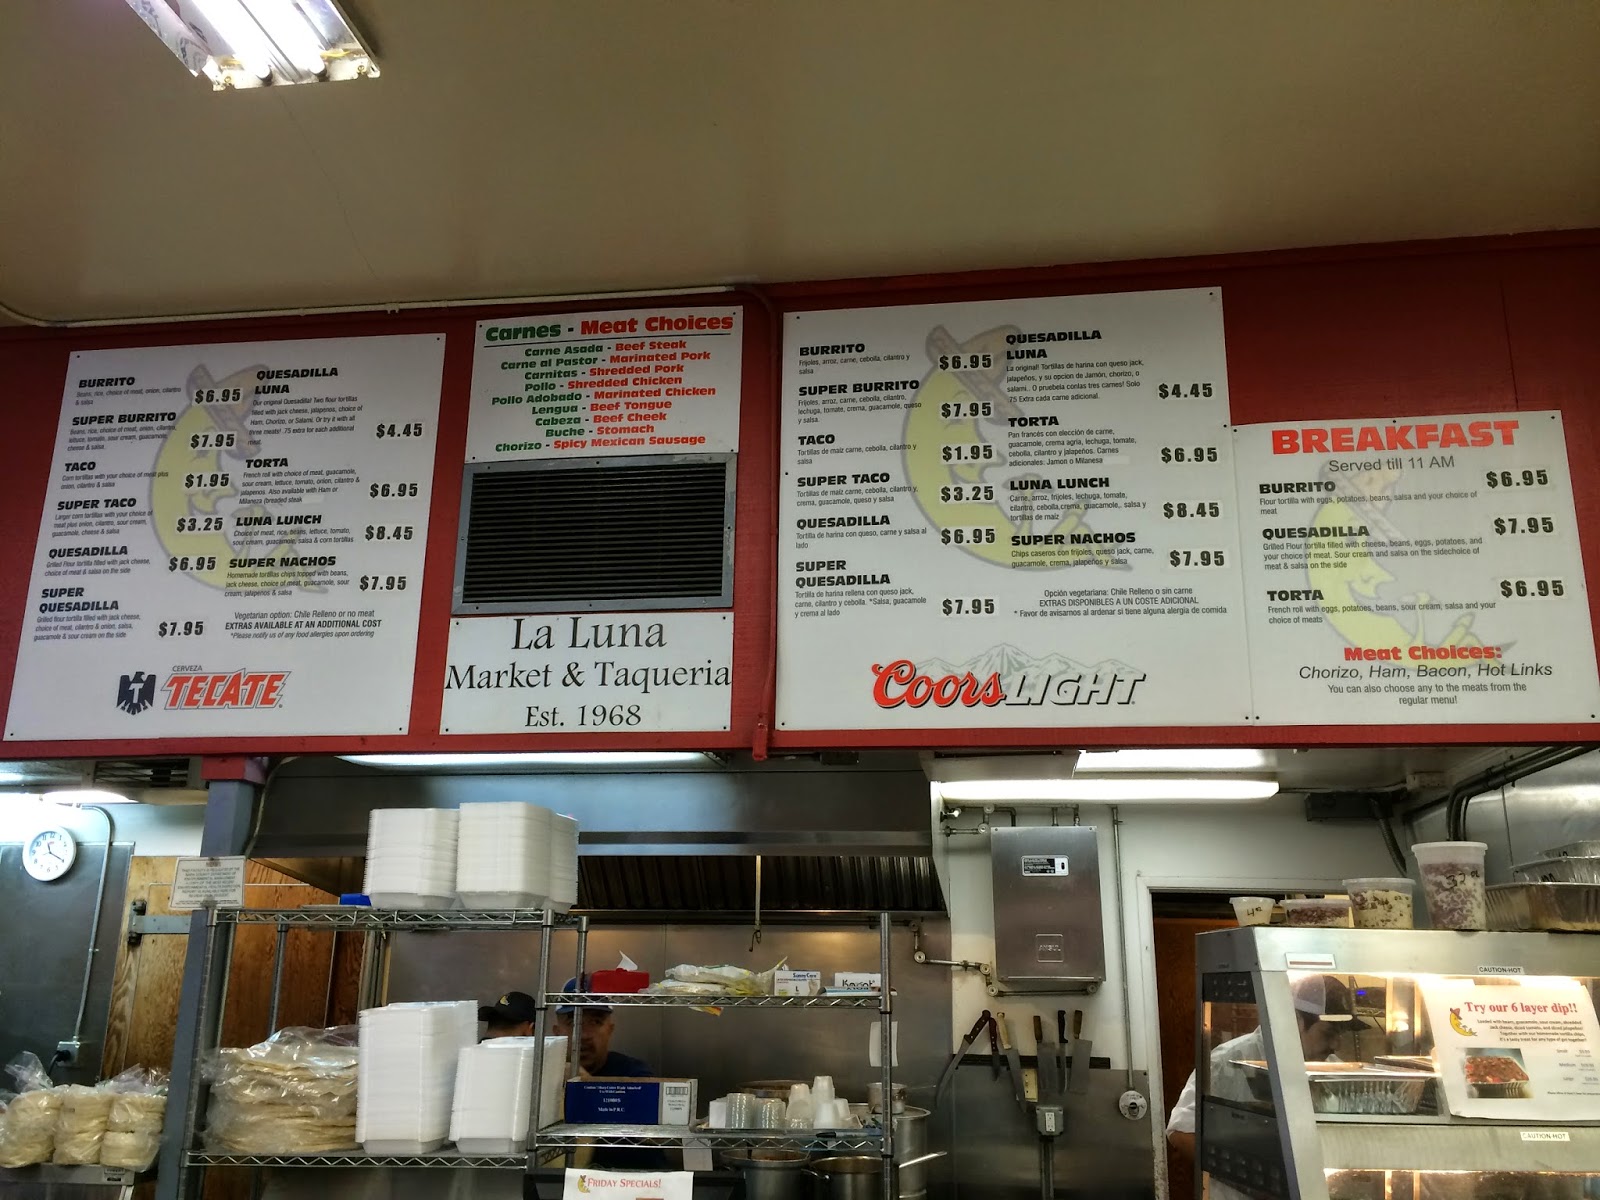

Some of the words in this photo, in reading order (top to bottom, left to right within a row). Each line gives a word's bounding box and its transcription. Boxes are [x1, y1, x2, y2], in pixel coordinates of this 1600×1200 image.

[486, 323, 561, 341] Carnes
[581, 319, 638, 334] Meat
[645, 315, 733, 332] Choices
[1006, 329, 1101, 345] QUESADILLA
[525, 346, 560, 356] Carne
[564, 344, 603, 354] Asada
[616, 341, 645, 351] Beef
[650, 340, 687, 350] Steak
[799, 343, 865, 356] BURRITO
[1006, 348, 1047, 360] LUNA
[501, 360, 536, 370] Carne
[540, 358, 551, 368] al
[556, 356, 598, 366] Pastor
[610, 353, 676, 363] Marinated
[680, 351, 710, 360] Pork
[939, 354, 992, 370] $6.95
[256, 367, 339, 380] QUESADILLA
[524, 369, 578, 380] Carnitas
[590, 366, 650, 376] Shredded
[655, 364, 684, 373] Pork
[79, 377, 135, 388] BURRITO
[254, 384, 290, 395] LUNA
[525, 382, 556, 391] Pollo
[568, 378, 628, 389] Shredded
[632, 376, 682, 386] Chicken
[799, 383, 848, 396] SUPER
[853, 379, 919, 392] BURRITO
[194, 388, 241, 404] $6.95
[492, 395, 522, 405] Pollo
[526, 392, 582, 403] Adobado
[594, 389, 662, 399] Marinated
[666, 386, 716, 397] Chicken
[1158, 383, 1213, 399] $4.45
[532, 404, 578, 415] Lengua
[590, 402, 620, 412] Beef
[624, 400, 672, 410] Tongue
[941, 403, 992, 419] $7.95
[72, 415, 114, 426] SUPER
[119, 412, 176, 423] BURRITO
[536, 416, 581, 426] Cabeza
[594, 414, 623, 423] Beef
[627, 412, 666, 422] Cheek
[1008, 416, 1059, 427] TORTA
[376, 423, 422, 439] $4.45
[546, 427, 585, 437] Buche
[597, 424, 654, 434] Stomach
[1272, 420, 1519, 454] BREAKFAST
[190, 434, 235, 449] $7.95
[496, 442, 542, 452] Chorizo
[554, 439, 587, 449] Spicy
[591, 436, 645, 446] Mexican
[649, 435, 705, 446] Sausage
[798, 434, 835, 445] TACO
[942, 445, 993, 461] $1.95
[1161, 448, 1218, 463] $6.95
[65, 462, 96, 471] TACO
[245, 458, 288, 468] TORTA
[1329, 459, 1382, 472] Served
[1386, 458, 1403, 471] till
[1409, 458, 1423, 469] 11
[1430, 456, 1455, 468] AM
[185, 473, 229, 489] $1.95
[797, 475, 847, 487] SUPER
[852, 472, 890, 484] TACO
[1010, 479, 1052, 490] LUNA
[1057, 477, 1110, 488] LUNCH
[1486, 470, 1548, 488] $6.95
[370, 483, 418, 499] $6.95
[941, 486, 994, 502] $3.25
[1259, 481, 1335, 494] BURRITO
[58, 500, 100, 510] SUPER
[104, 498, 136, 508] TACO
[1337, 495, 1366, 503] potatoes,
[1370, 494, 1391, 502] beans,
[1163, 503, 1220, 518] $8.45
[176, 517, 224, 533] $3.25
[236, 516, 272, 527] LUNA
[276, 514, 322, 525] LUNCH
[797, 514, 890, 530] QUESADILLA
[1494, 517, 1554, 536] $7.95
[365, 526, 413, 542] $8.45
[941, 529, 996, 545] $6.95
[1011, 533, 1066, 546] SUPER
[1070, 532, 1136, 544] NACHOS
[1262, 526, 1369, 540] QUESADILLA
[49, 545, 128, 558] QUESADILLA
[1170, 551, 1225, 566] $7.95
[169, 556, 216, 572] $6.95
[229, 557, 276, 568] SUPER
[280, 556, 336, 567] NACHOS
[795, 560, 846, 572] SUPER
[360, 575, 406, 591] $7.95
[795, 574, 890, 588] QUESADILLA
[41, 587, 84, 598] SUPER
[1268, 589, 1324, 602] TORTA
[1500, 580, 1564, 598] $6.95
[39, 600, 119, 612] QUESADILLA
[942, 599, 995, 615] $7.95
[1040, 599, 1066, 607] EXTRAS
[158, 621, 204, 637] $7.95
[225, 622, 252, 630] EXTRAS
[254, 621, 292, 629] AVAILABLE
[317, 620, 360, 628] ADDITIONAL
[363, 619, 381, 627] COST
[511, 619, 555, 650] La
[568, 617, 667, 648] Luna
[1344, 646, 1401, 661] Meat
[1408, 646, 1502, 660] Choices:
[445, 662, 552, 689] Market
[561, 662, 585, 687] &
[594, 660, 731, 693] Taqueria
[1300, 666, 1363, 680] Chorizo,
[1369, 666, 1410, 679] Ham,
[1417, 665, 1472, 678] Bacon,
[1478, 664, 1506, 676] Hot
[1511, 664, 1552, 676] Links
[167, 674, 282, 707] TECATE
[872, 659, 1006, 708] Coors
[1006, 674, 1147, 706] LIGHT
[1328, 684, 1344, 694] You
[1364, 684, 1381, 692] also
[1384, 683, 1415, 692] choose
[1418, 684, 1432, 694] any
[1435, 684, 1444, 692] to
[1447, 683, 1459, 692] the
[1462, 683, 1488, 692] meats
[1490, 682, 1511, 691] from
[1513, 682, 1526, 691] the
[129, 682, 143, 704] T
[1399, 696, 1428, 706] regular
[1431, 695, 1458, 704] menu!
[525, 706, 565, 727] Est.
[578, 704, 641, 726] 1968
[1464, 1001, 1486, 1014] Try
[1489, 1004, 1509, 1013] our
[1512, 1003, 1518, 1012] 6
[1521, 1003, 1548, 1014] layer
[1551, 1003, 1577, 1015] dip!!
[588, 1178, 617, 1187] FRIDAY
[620, 1179, 661, 1188] SPECIALS!
